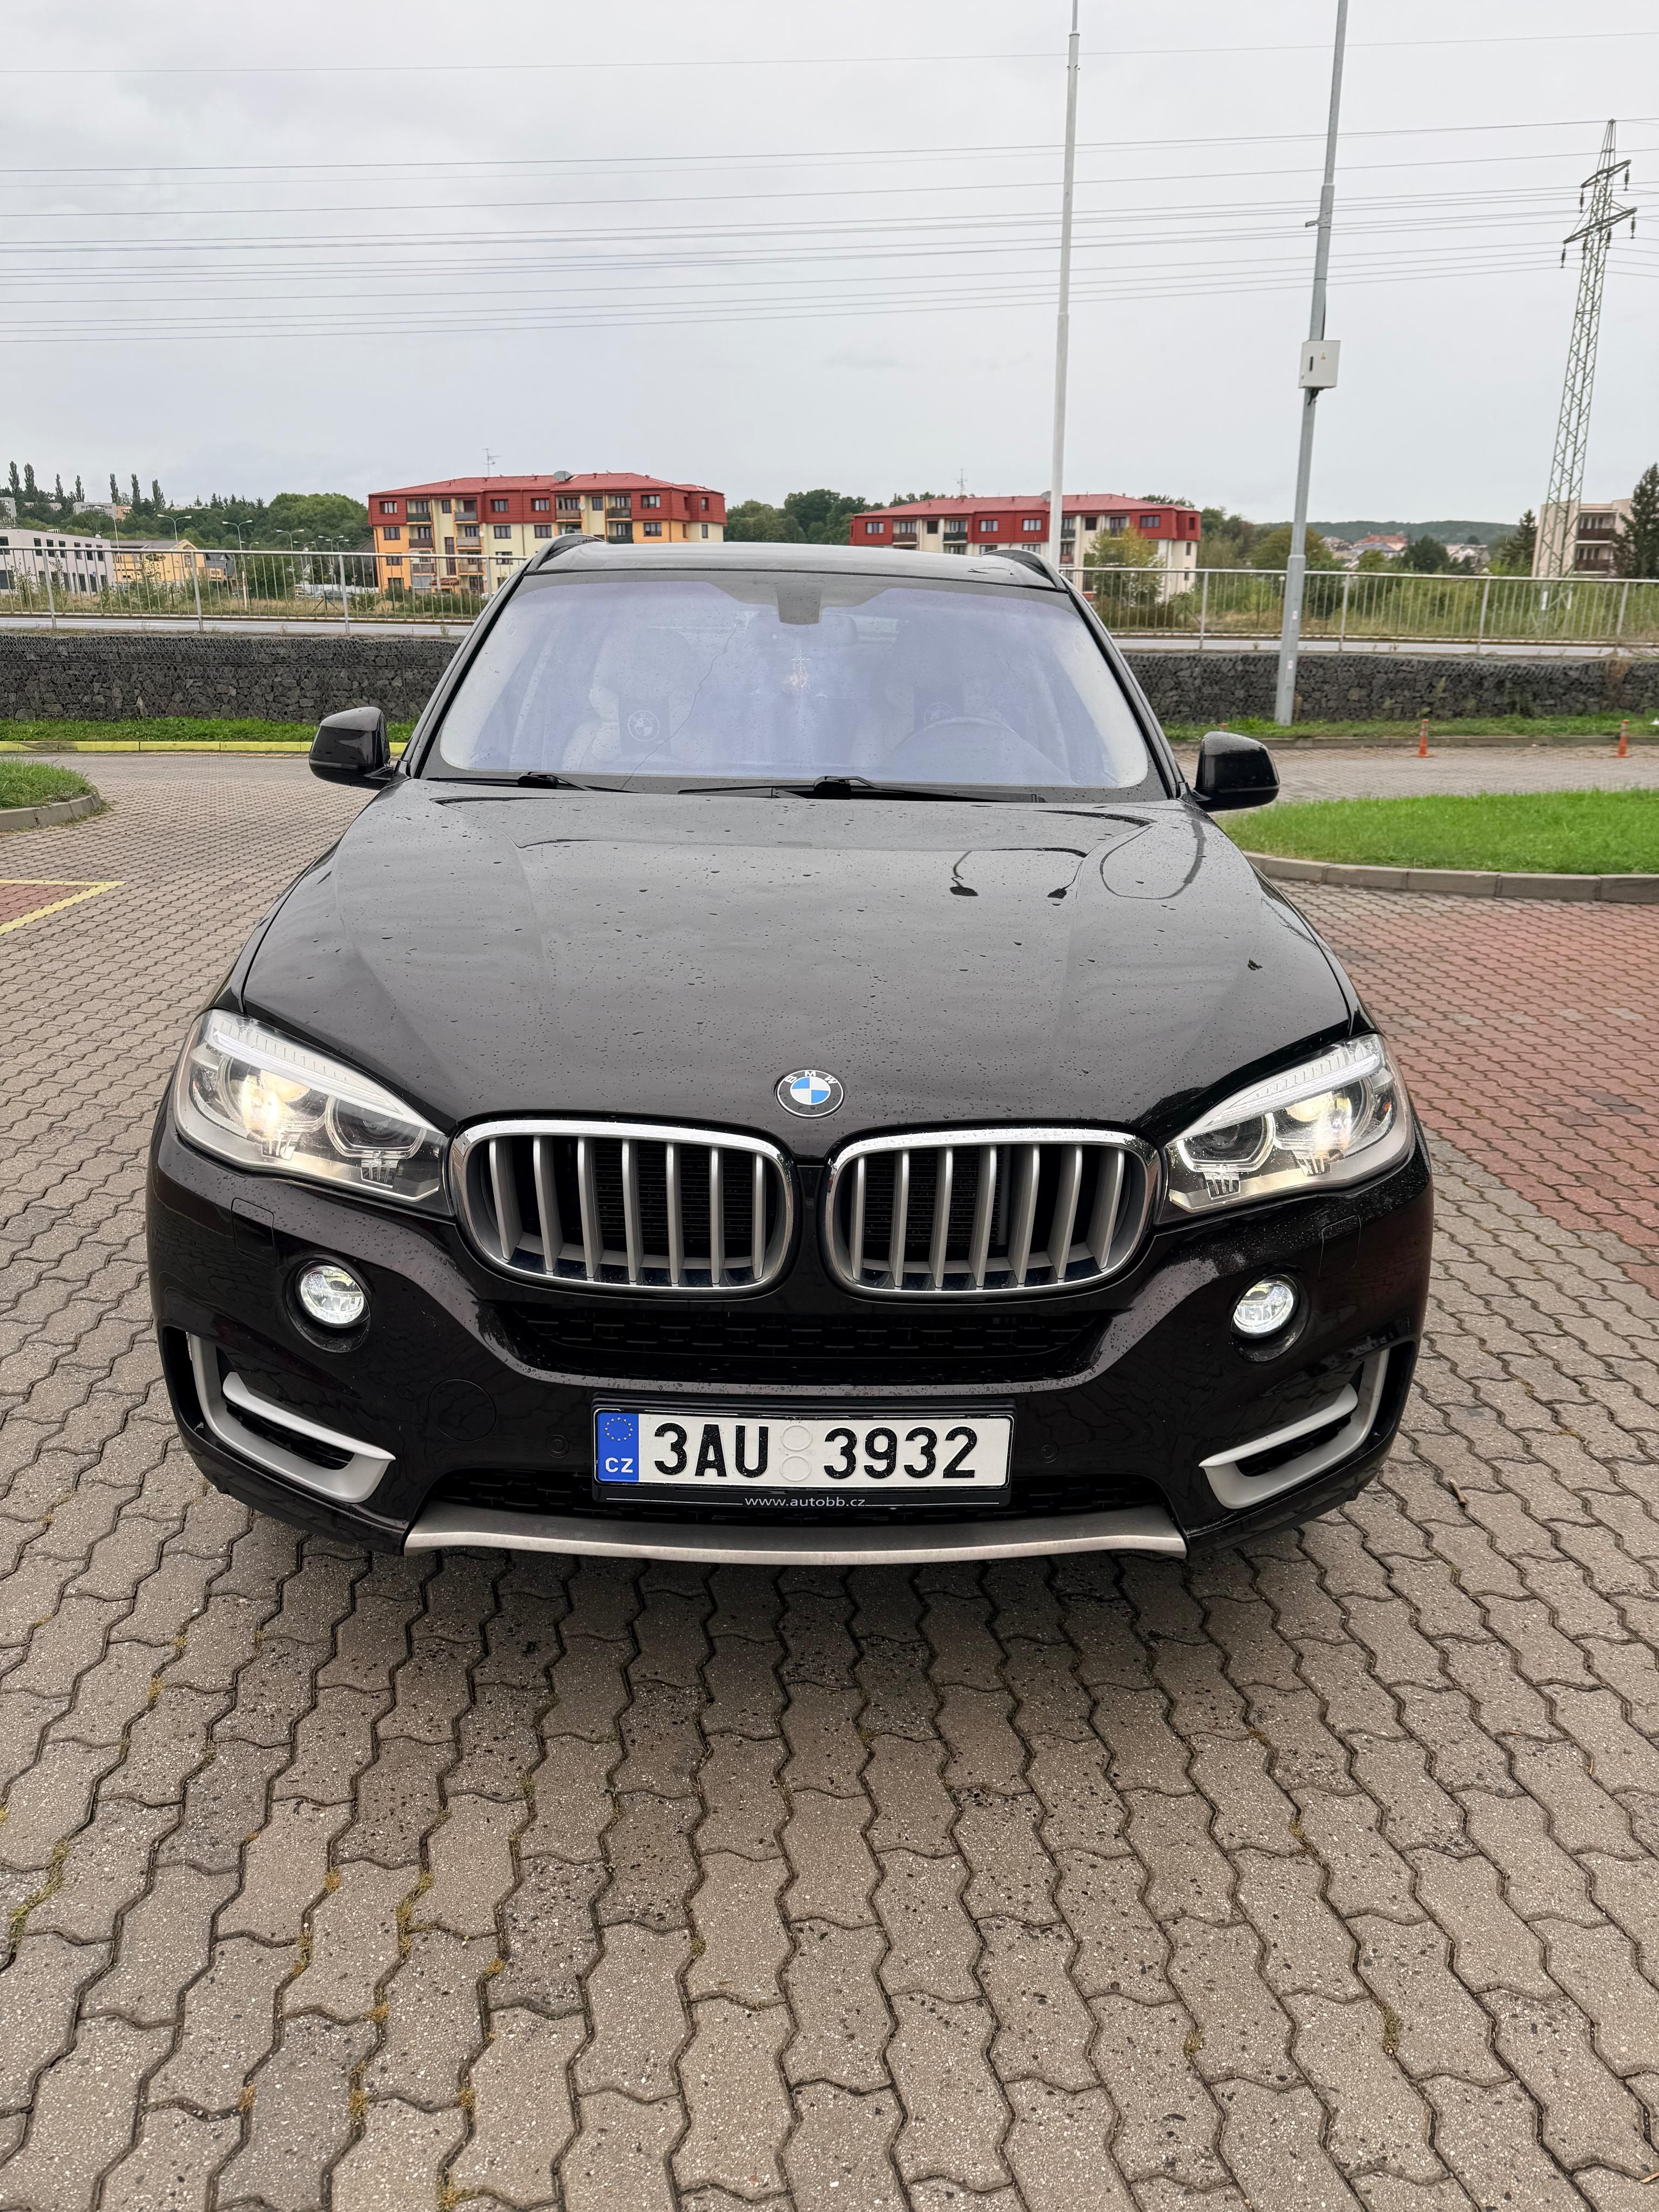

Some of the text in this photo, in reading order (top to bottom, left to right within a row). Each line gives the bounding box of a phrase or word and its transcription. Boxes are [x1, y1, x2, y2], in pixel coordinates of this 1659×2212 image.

[784, 1070, 838, 1084] BMW
[654, 1422, 978, 1480] 3AU 3932
[605, 1457, 633, 1473] CZ
[745, 1496, 866, 1507] www.autobb.cz
